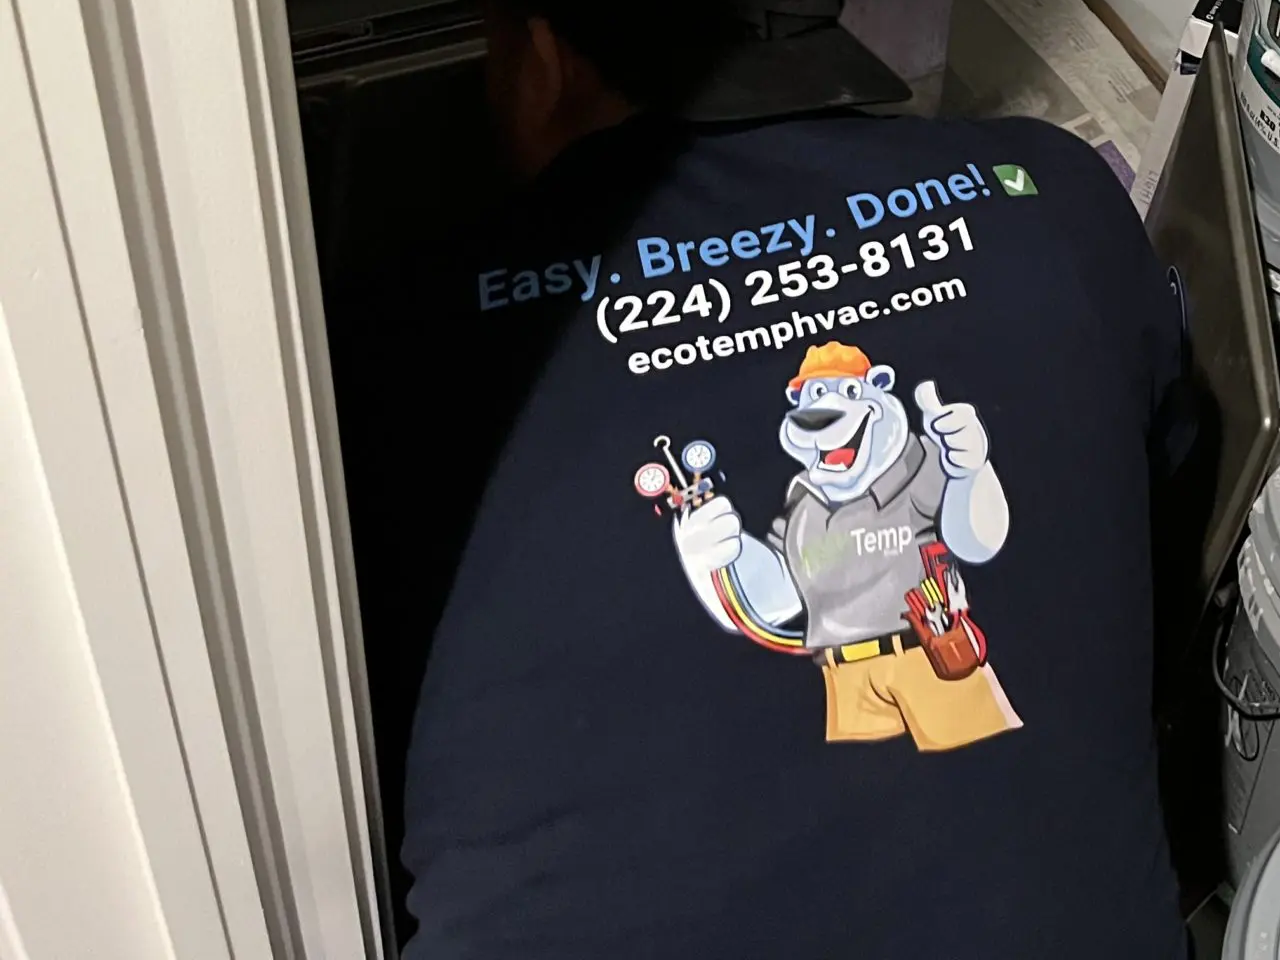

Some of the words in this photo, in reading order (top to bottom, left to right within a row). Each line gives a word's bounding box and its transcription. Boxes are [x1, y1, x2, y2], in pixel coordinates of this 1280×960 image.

[478, 253, 621, 311] Easy.
[637, 214, 837, 279] Breezy.
[845, 163, 992, 230] Done!
[596, 277, 732, 344] (224)
[743, 216, 975, 307] 253-8131
[627, 273, 968, 375] ecotemphvac.com
[850, 525, 913, 556] Temp
